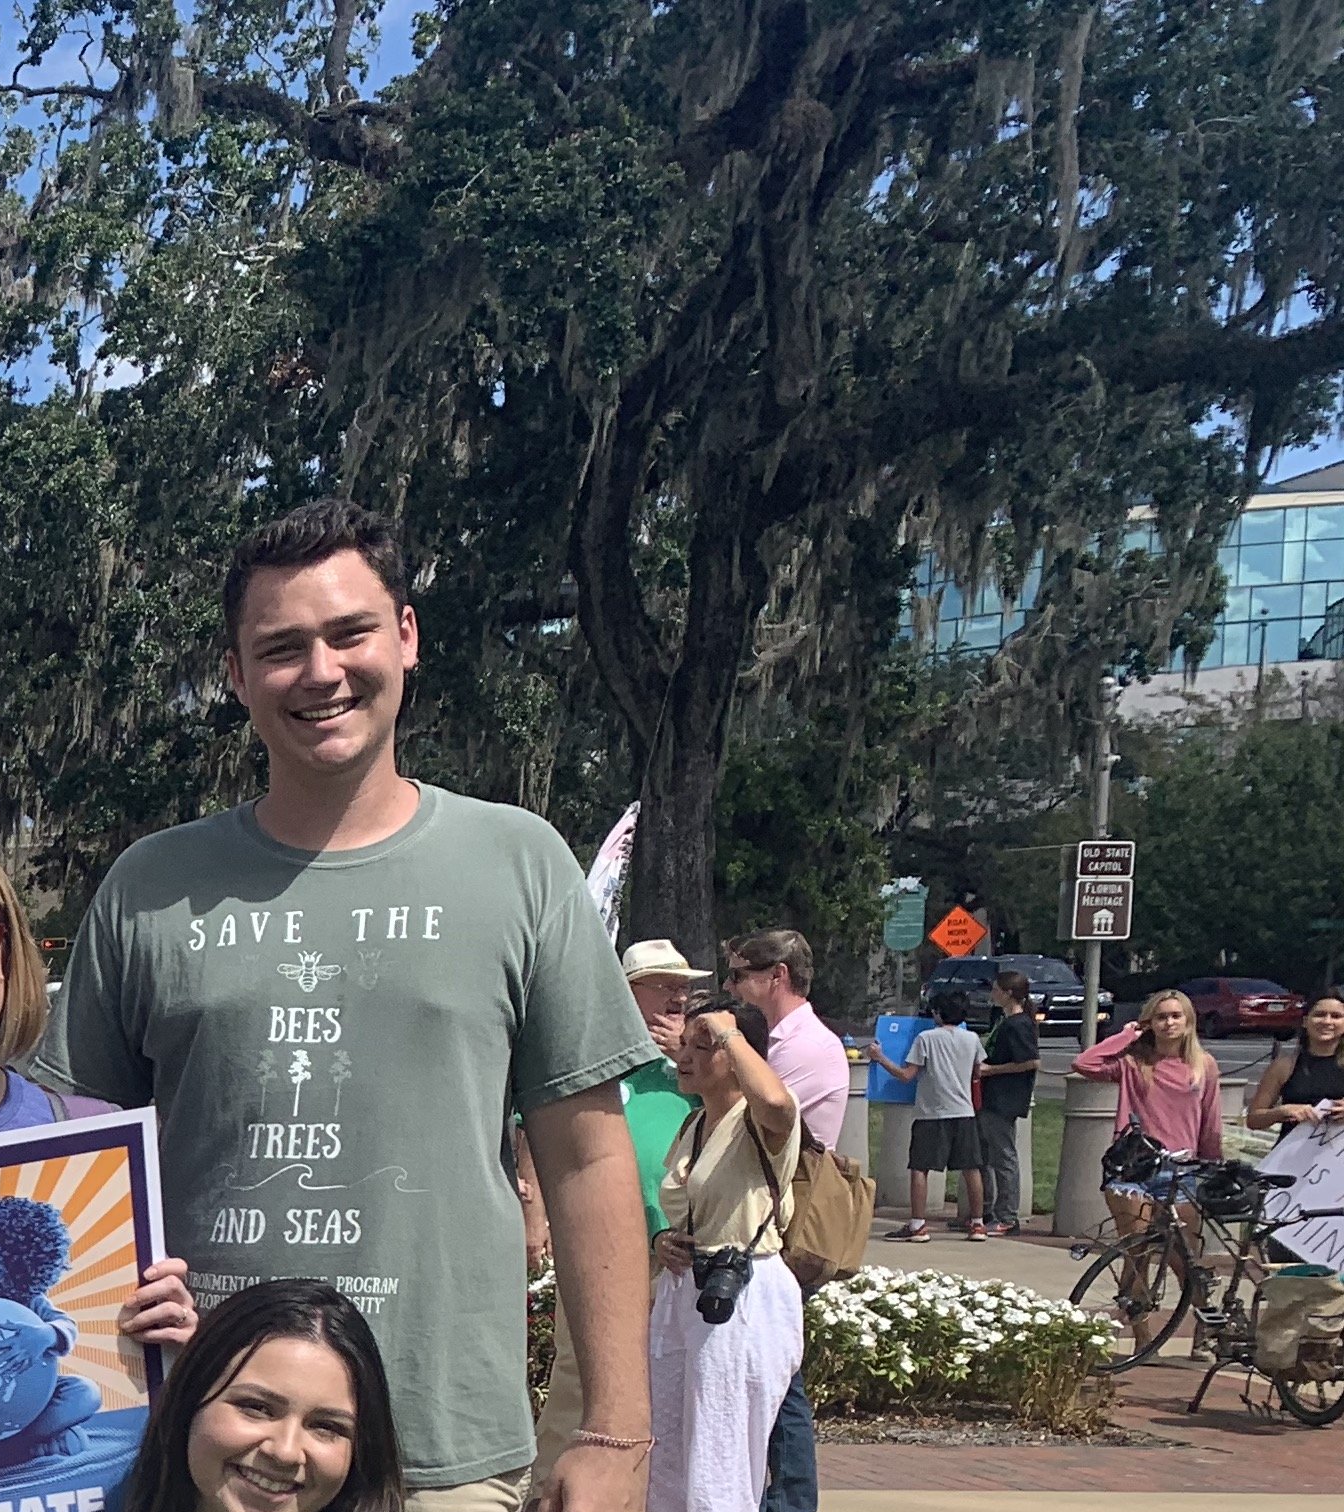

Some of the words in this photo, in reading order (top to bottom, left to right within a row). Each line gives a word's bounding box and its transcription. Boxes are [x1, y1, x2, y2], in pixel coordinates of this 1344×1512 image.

[189, 910, 304, 951] SAVE
[351, 905, 443, 942] THE
[268, 1006, 342, 1043] BEES
[248, 1123, 342, 1159] TREES
[1303, 1164, 1330, 1185] IS
[210, 1208, 266, 1244] AND
[284, 1208, 362, 1245] SEAS
[336, 1275, 399, 1294] PROGRAM
